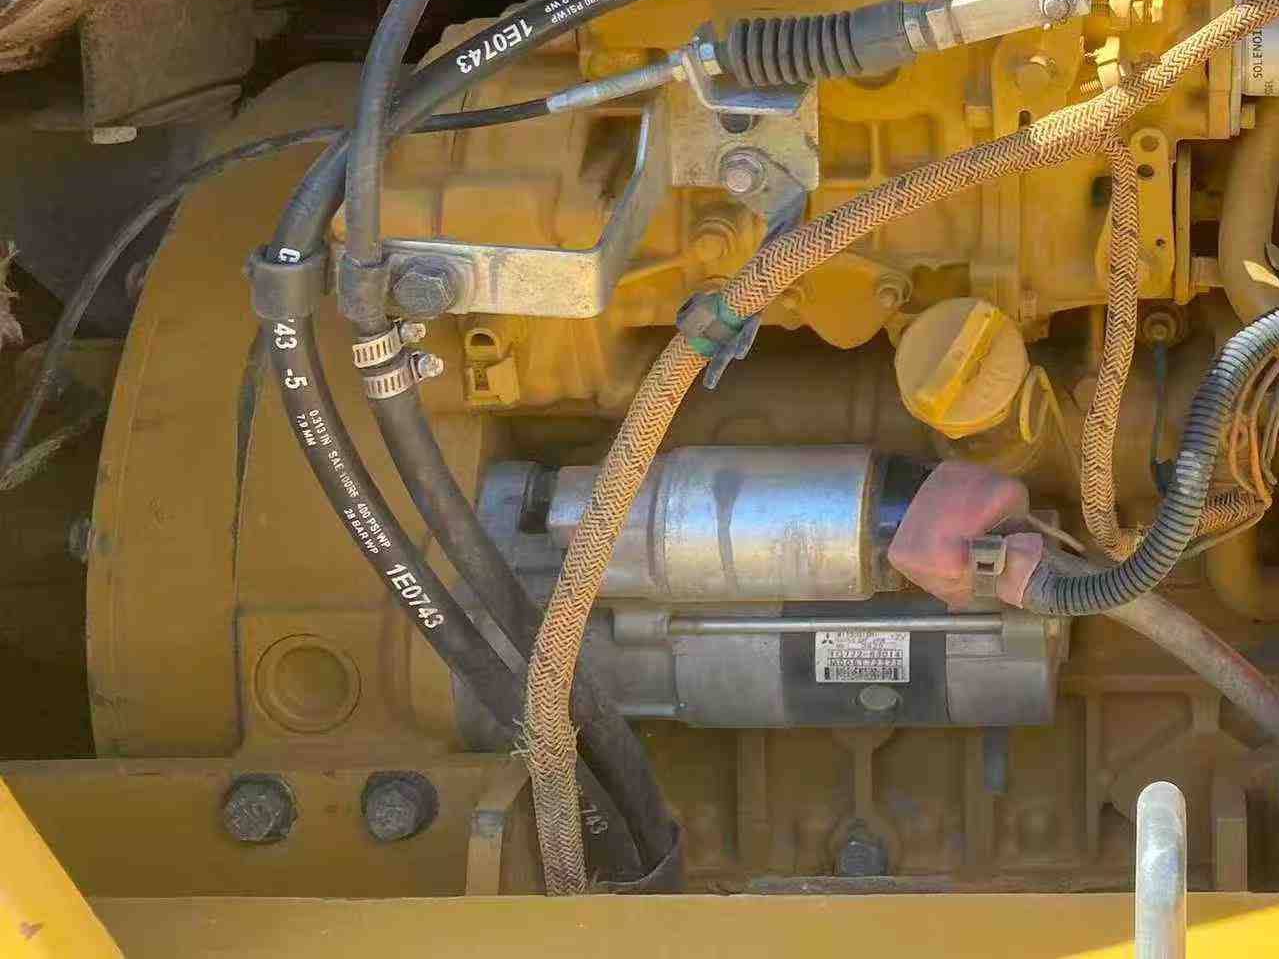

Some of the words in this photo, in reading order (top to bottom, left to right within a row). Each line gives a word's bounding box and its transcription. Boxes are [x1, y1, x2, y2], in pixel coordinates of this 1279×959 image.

[544, 0, 561, 14] WP
[456, 17, 534, 74] 1E0743
[1252, 27, 1264, 79] SOLENOI
[357, 502, 372, 520] 400
[386, 563, 445, 629] 1E0743
